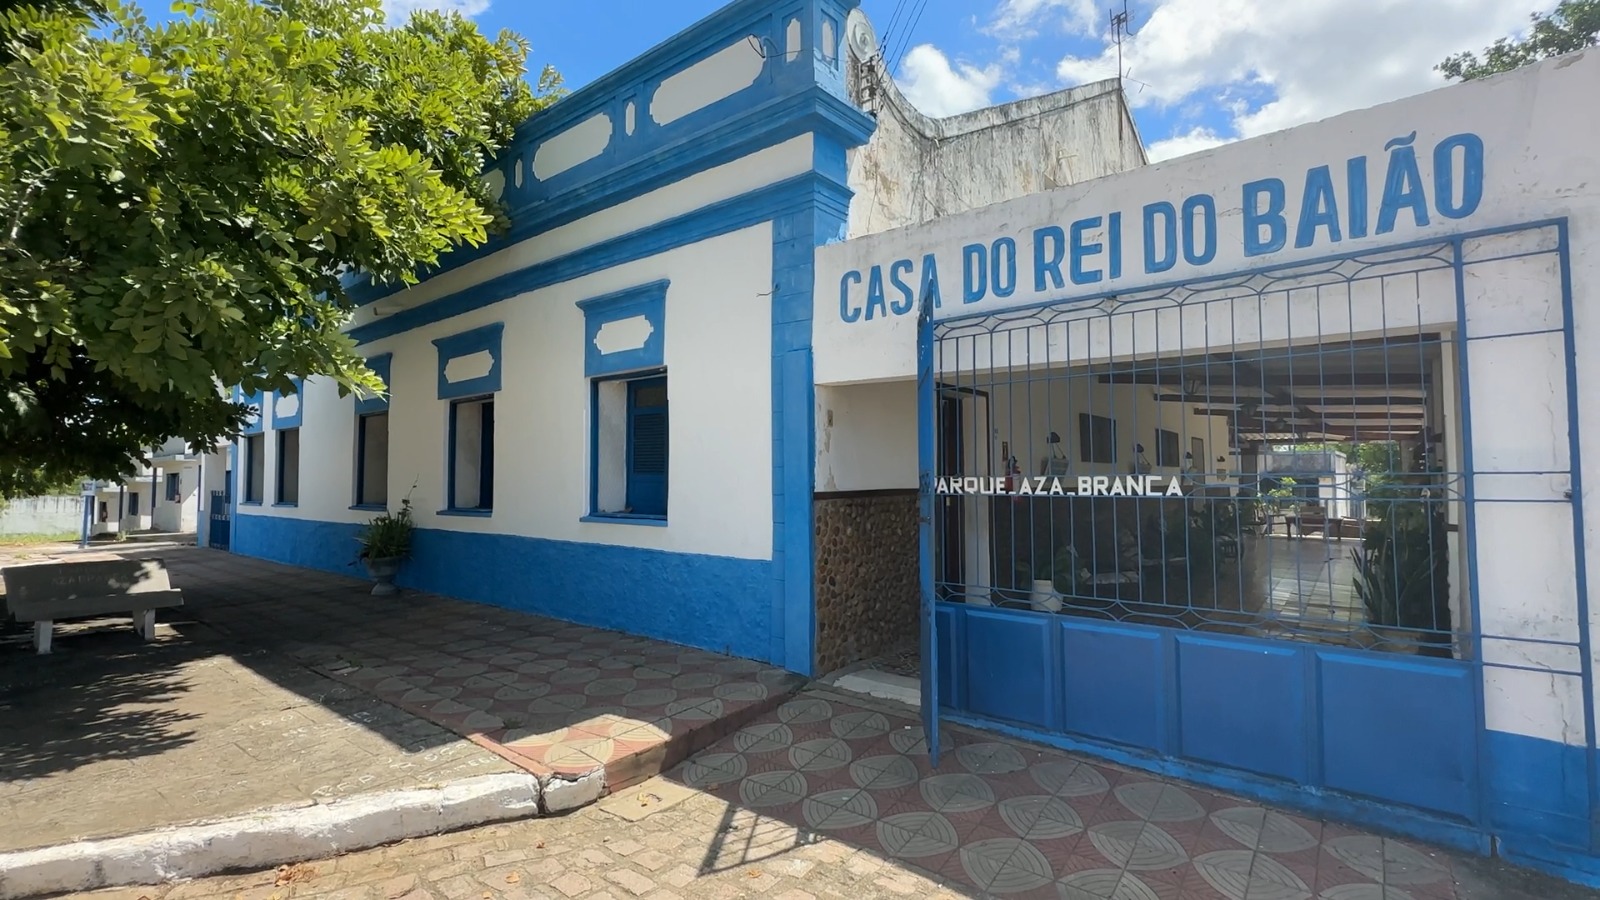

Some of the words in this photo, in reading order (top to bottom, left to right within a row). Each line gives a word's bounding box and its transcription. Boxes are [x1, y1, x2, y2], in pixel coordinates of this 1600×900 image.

[840, 253, 941, 323] CASA
[963, 237, 1017, 304] DO
[1033, 211, 1122, 292] REI
[1143, 193, 1217, 274] DO
[1242, 130, 1484, 257] BAIÃO
[934, 476, 1007, 495] ARQUE
